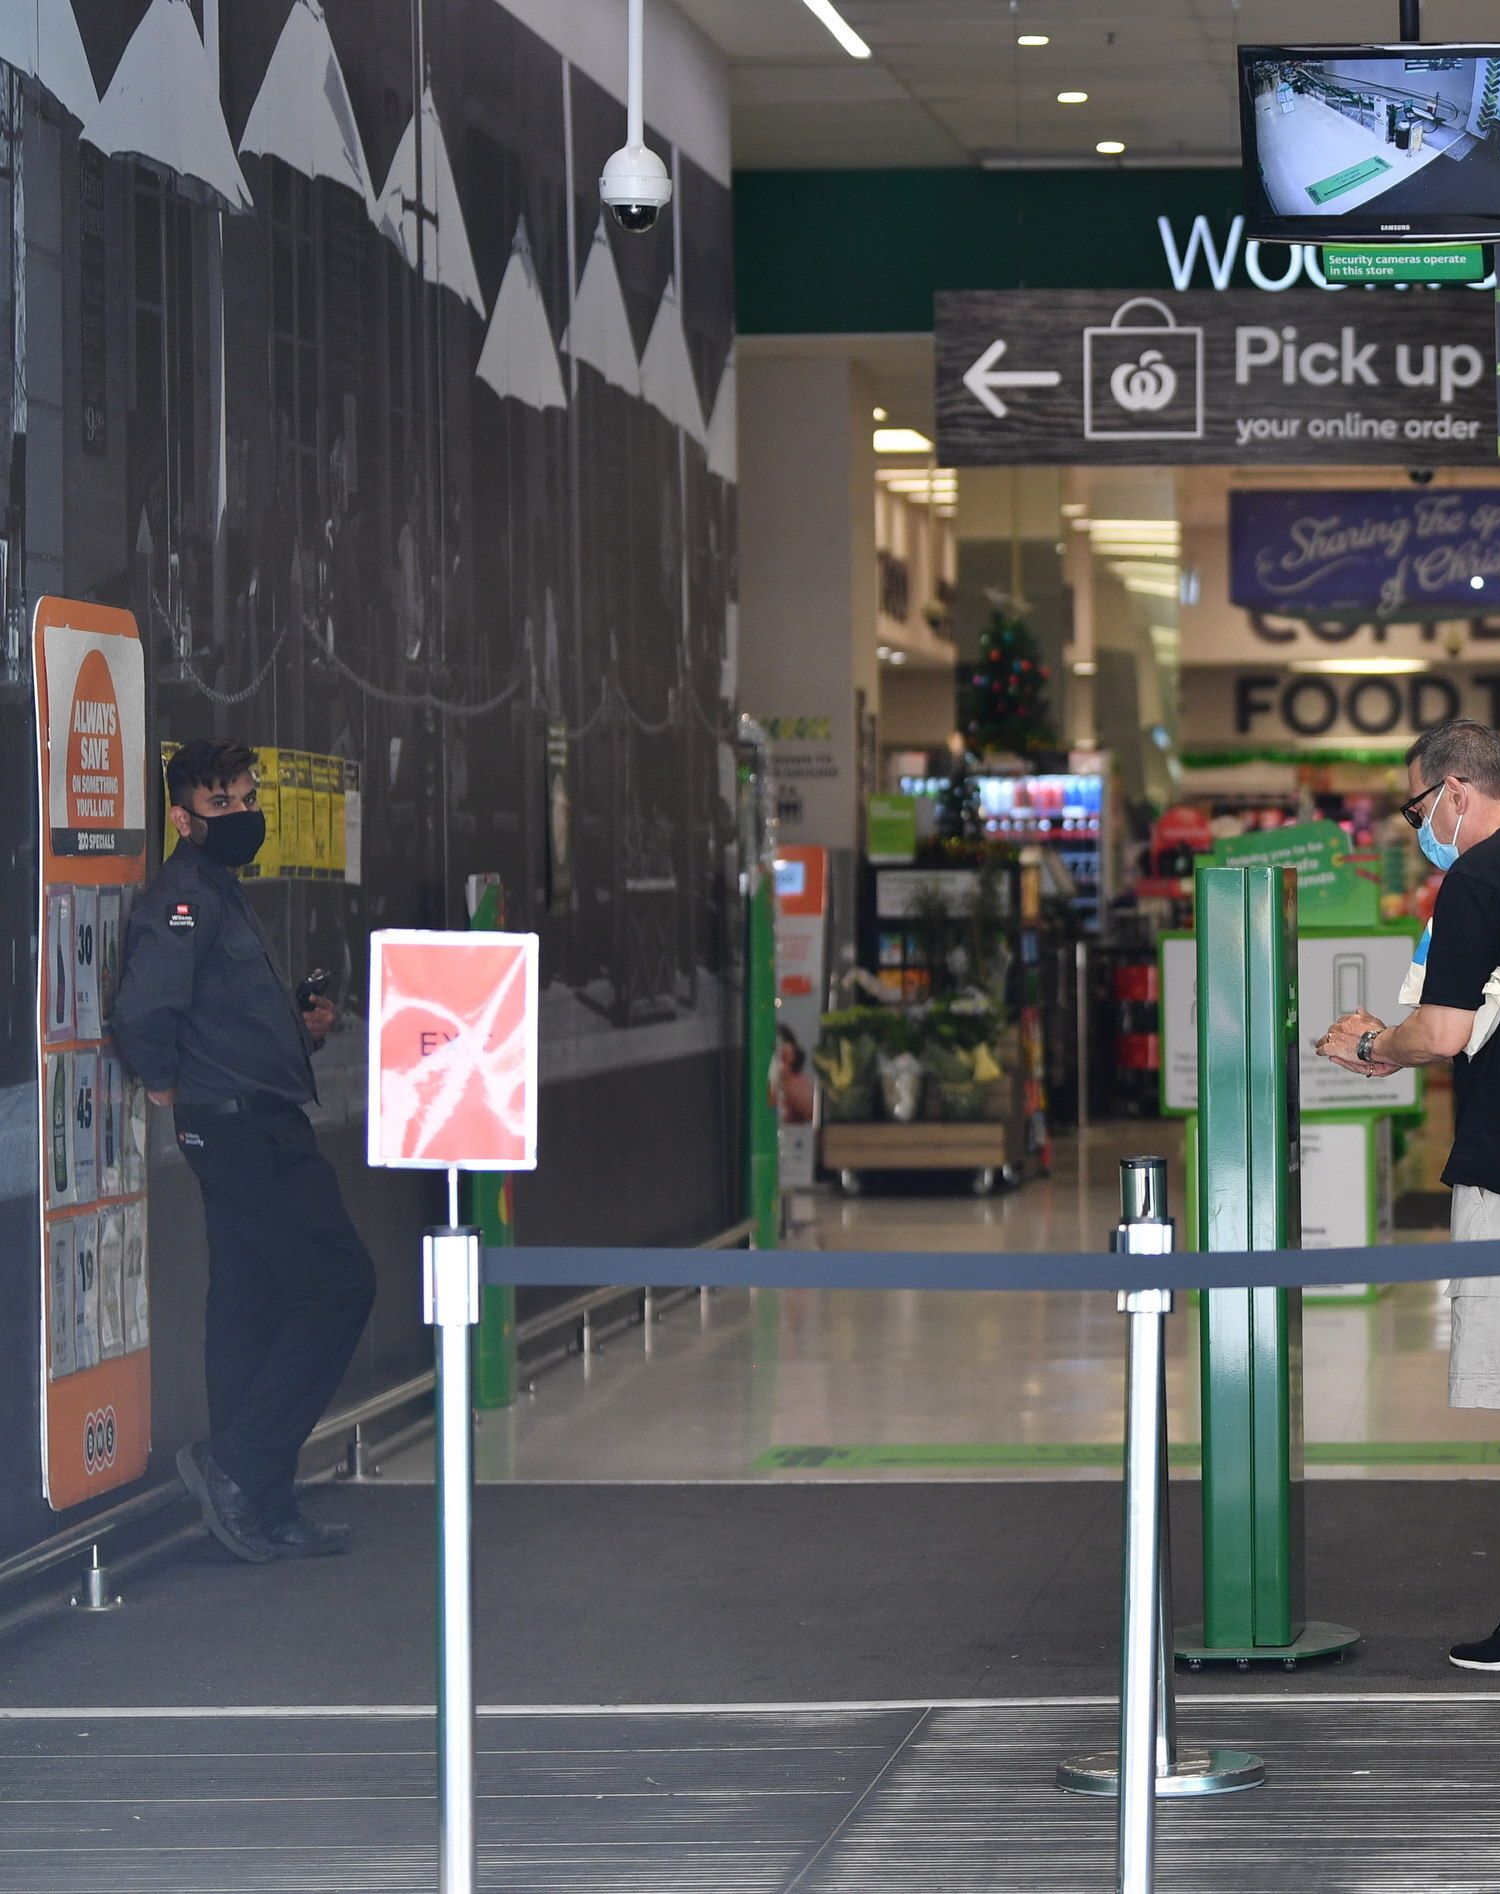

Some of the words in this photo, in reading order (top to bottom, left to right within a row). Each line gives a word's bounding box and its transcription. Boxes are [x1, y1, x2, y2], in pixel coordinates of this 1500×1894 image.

[1329, 255, 1373, 265] Security
[1375, 256, 1421, 264] cameras
[1423, 255, 1466, 266] operate
[1330, 266, 1340, 275] in
[1342, 266, 1363, 275] this
[1365, 266, 1394, 275] store
[1235, 325, 1381, 386] Pick
[1395, 343, 1485, 404] up
[1235, 416, 1301, 446] your
[1307, 411, 1398, 440] online
[1403, 413, 1480, 440] order
[1234, 671, 1461, 736] FOOD
[73, 700, 117, 736] ALWAYS
[80, 736, 110, 771] SAVE
[72, 774, 82, 793] ON
[82, 775, 119, 795] SOMETHING
[76, 798, 98, 817] YOU'LL
[98, 799, 115, 817] LOVE
[89, 833, 115, 850] SPECIALS
